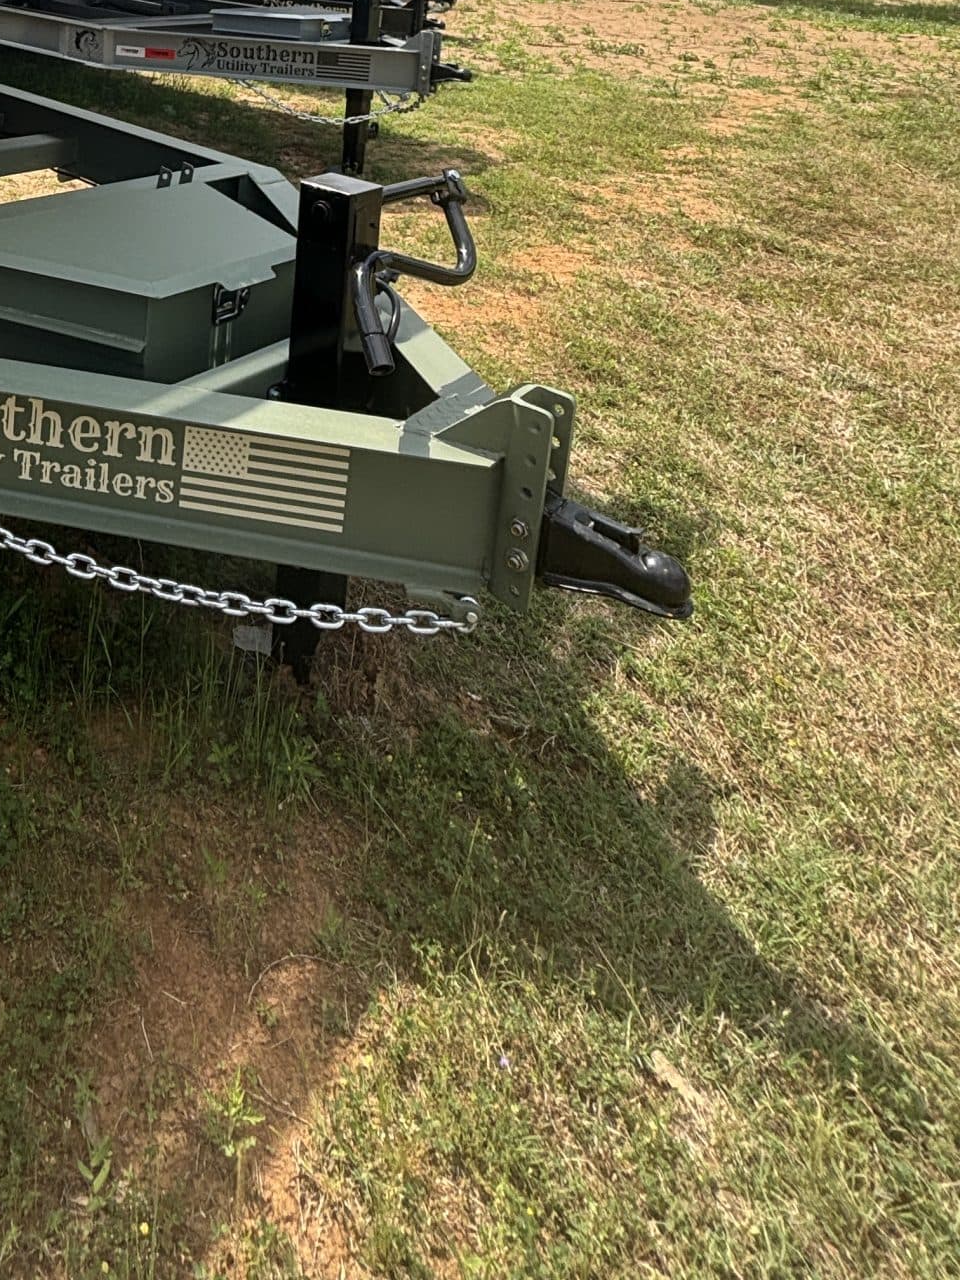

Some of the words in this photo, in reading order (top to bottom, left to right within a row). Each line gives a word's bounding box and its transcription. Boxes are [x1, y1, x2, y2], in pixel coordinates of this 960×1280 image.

[216, 41, 315, 65] Southern
[216, 60, 258, 75] Utility
[260, 62, 315, 77] Trailers
[13, 447, 174, 504] Trailers
